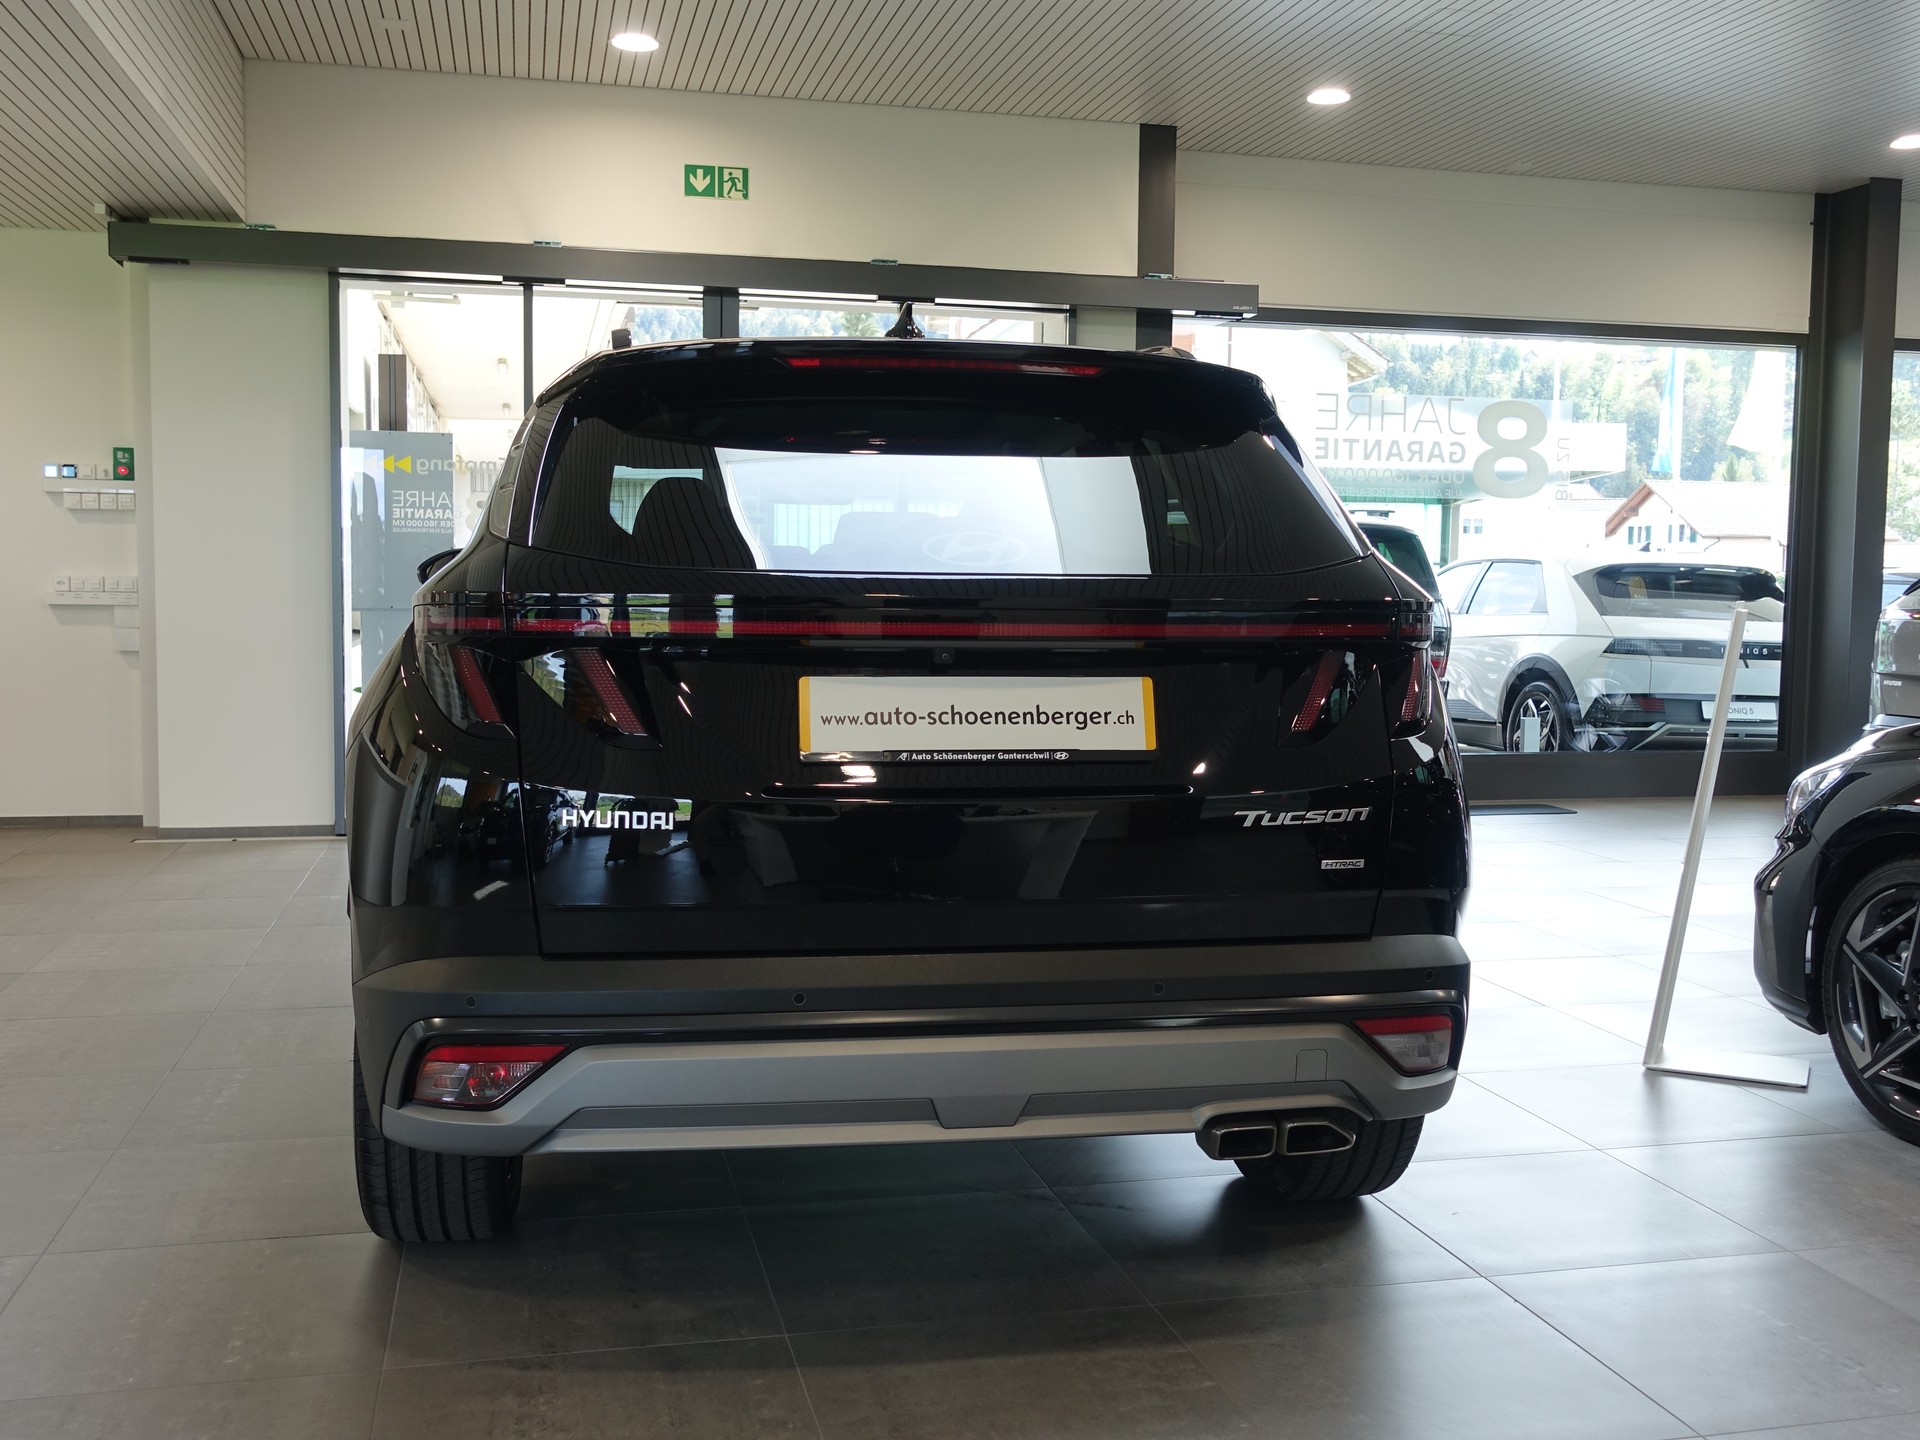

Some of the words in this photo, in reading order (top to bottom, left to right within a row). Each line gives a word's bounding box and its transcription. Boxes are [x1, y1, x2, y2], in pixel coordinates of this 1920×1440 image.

[1728, 707, 1748, 715] ONIQ
[820, 704, 1135, 731] www.auto-schoenenberger.ch
[911, 752, 931, 760] Auto
[933, 751, 996, 761] Schönenberger
[997, 751, 1050, 760] Ganterschwil
[562, 809, 674, 830] HYUNDAI
[1324, 860, 1362, 868] HTRAC
